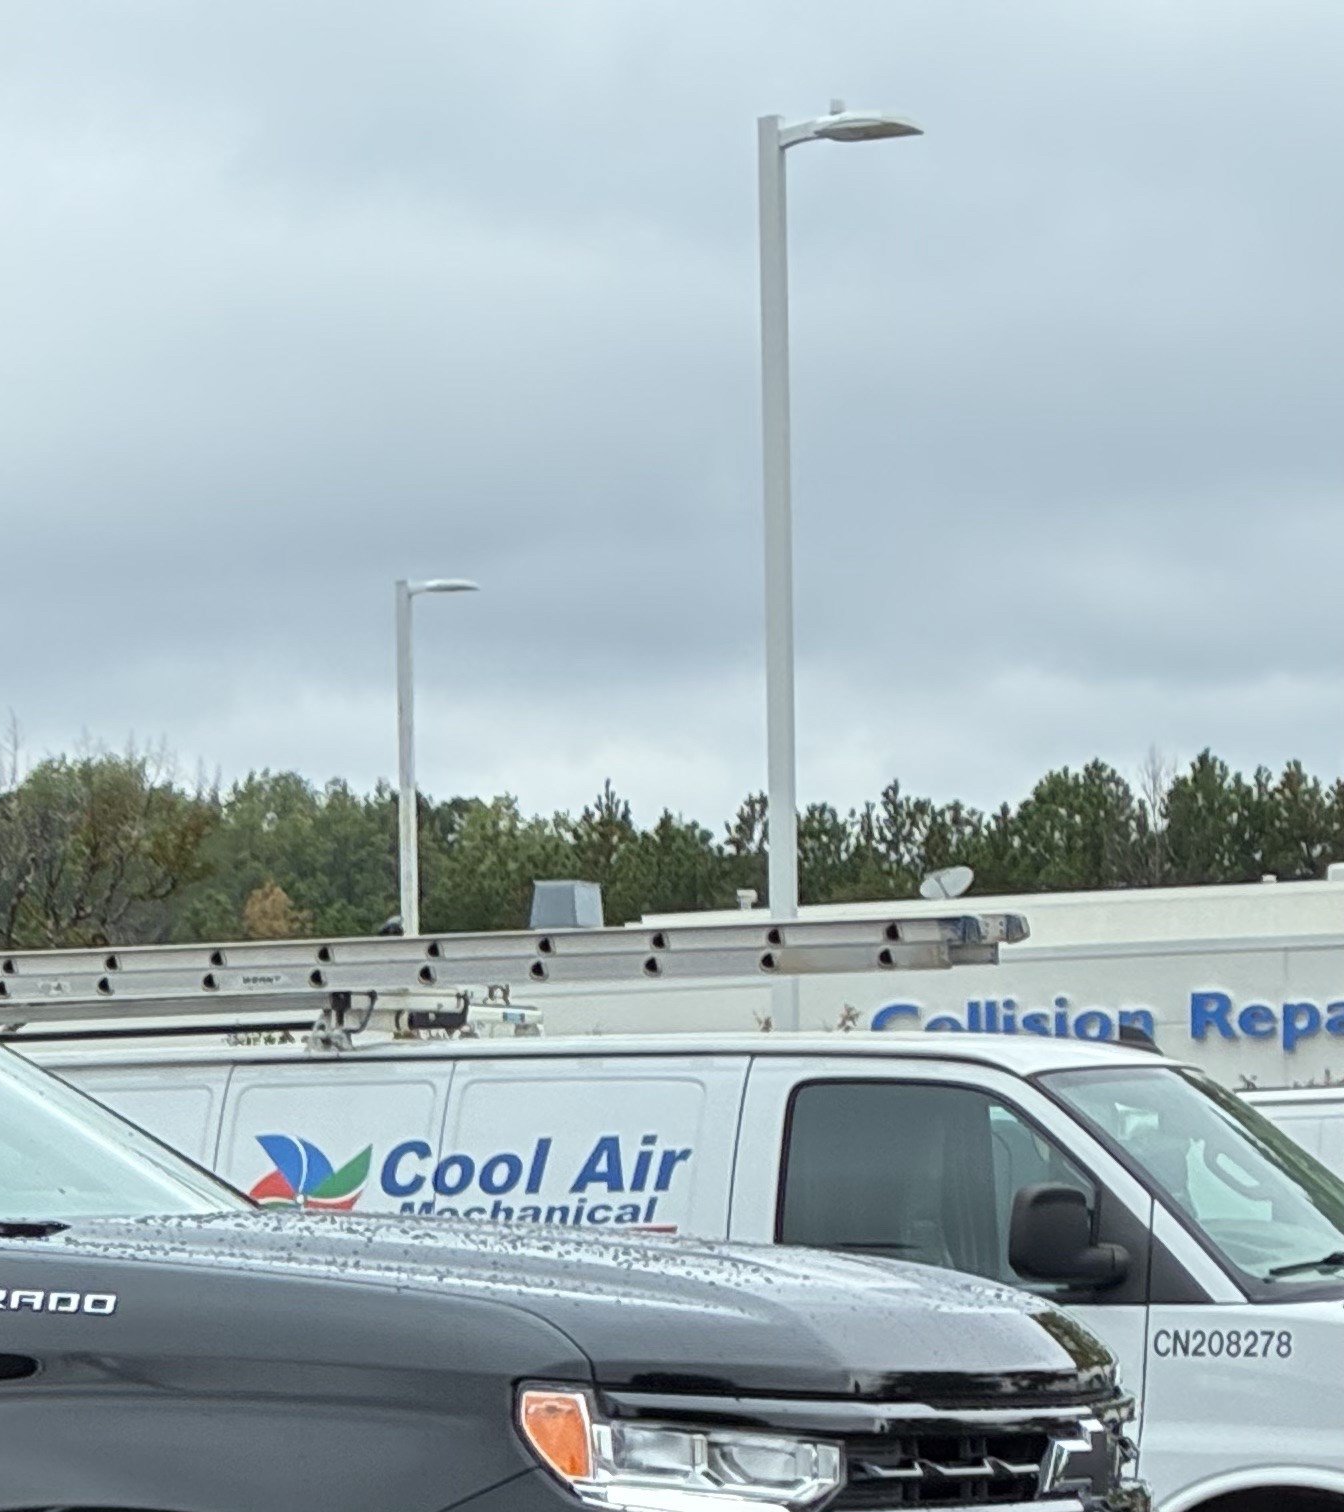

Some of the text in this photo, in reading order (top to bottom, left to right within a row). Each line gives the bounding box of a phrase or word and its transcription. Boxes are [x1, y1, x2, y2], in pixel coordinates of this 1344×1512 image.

[379, 1134, 693, 1198] Cool Air
[1153, 1328, 1293, 1358] CN208278
